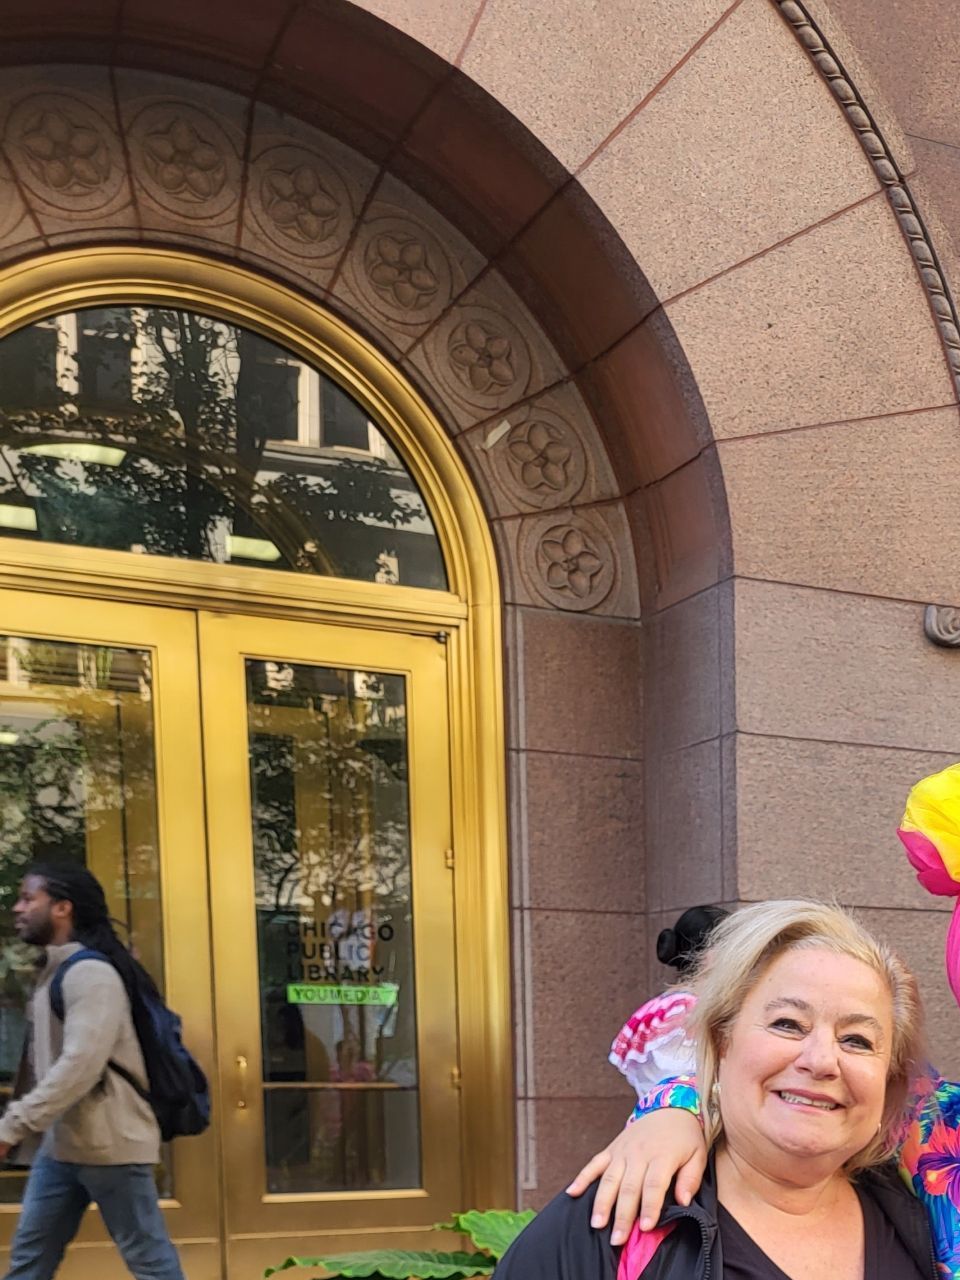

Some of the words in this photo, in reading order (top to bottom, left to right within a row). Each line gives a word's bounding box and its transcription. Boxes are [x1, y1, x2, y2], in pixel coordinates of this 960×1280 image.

[287, 922, 394, 942] CHICAGO
[287, 941, 371, 961] PUBLIC
[287, 964, 384, 982] LIBRARY
[293, 987, 383, 1003] YOUMEDIA
